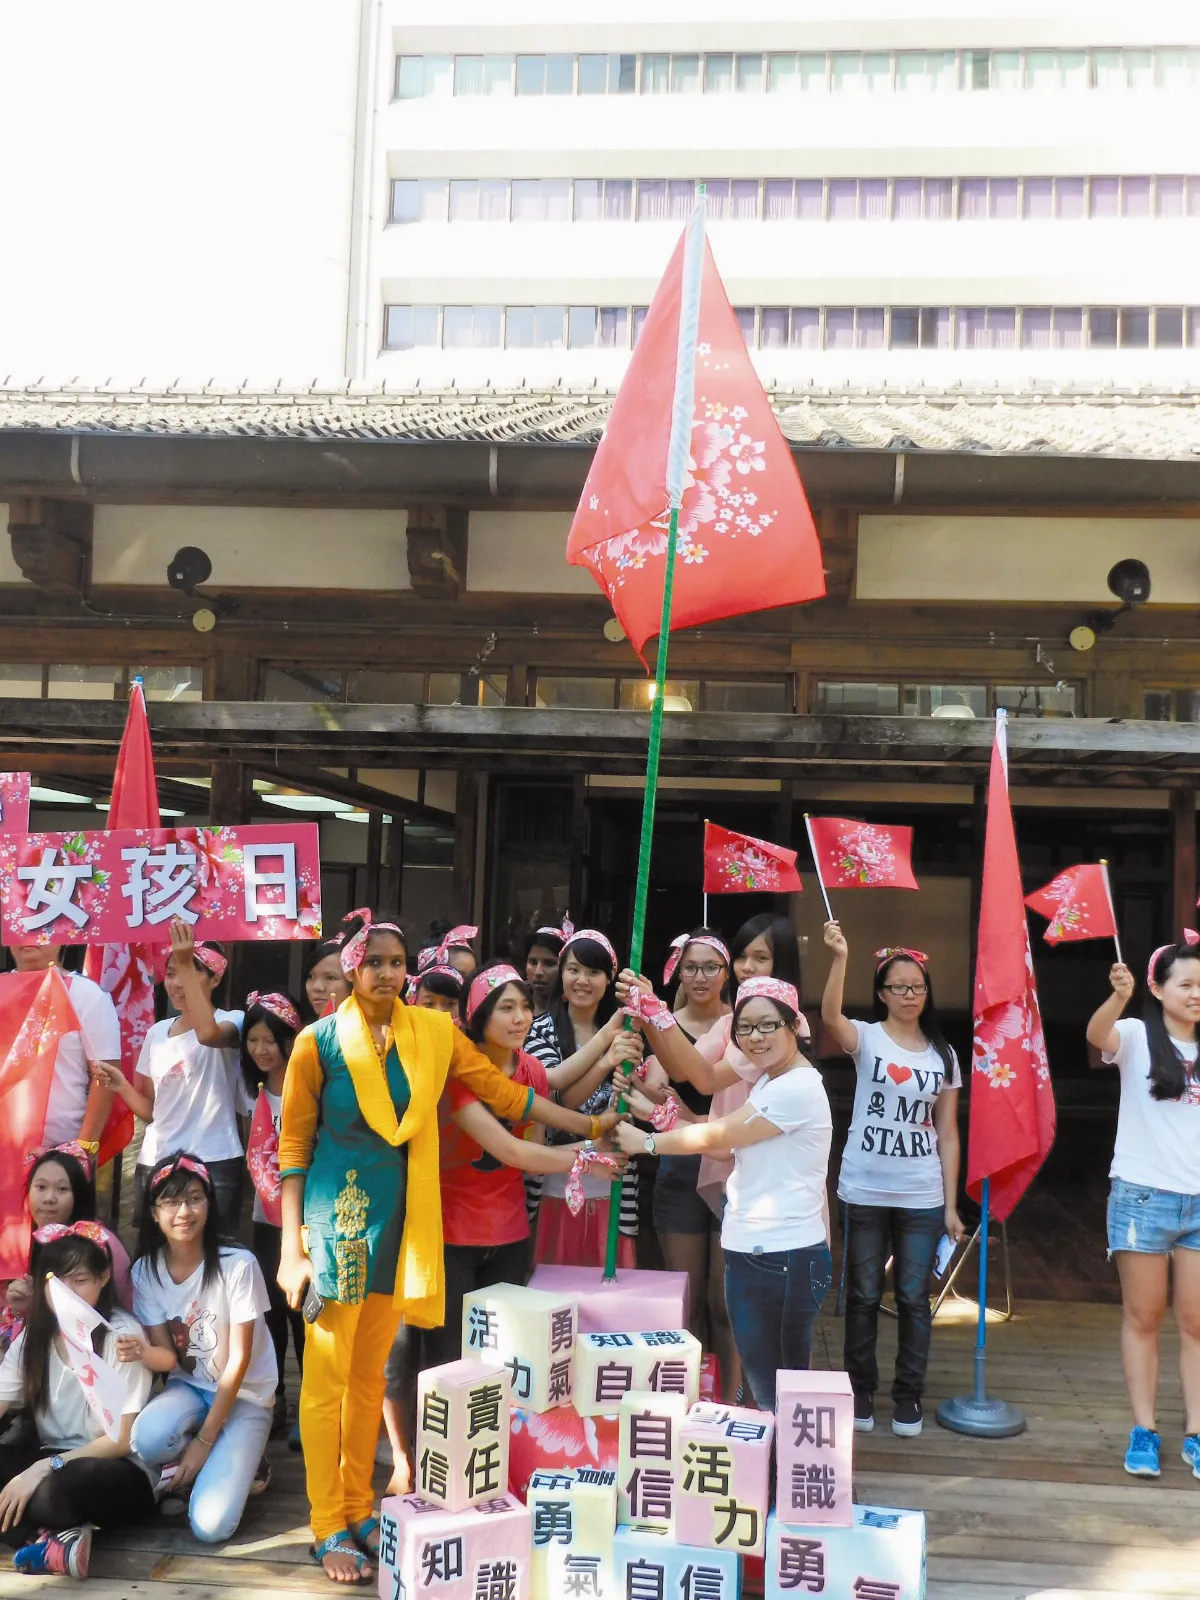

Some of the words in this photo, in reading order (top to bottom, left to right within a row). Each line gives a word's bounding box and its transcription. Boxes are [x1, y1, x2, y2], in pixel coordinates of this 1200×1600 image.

[18, 842, 298, 930] 女孩日
[861, 1125, 932, 1157] STAR!
[469, 1306, 531, 1398] 活力
[548, 1308, 573, 1402] 勇氣
[590, 1330, 685, 1347] 知識
[595, 1361, 687, 1402] 自信
[420, 1390, 449, 1499] 自信
[464, 1383, 503, 1499] 責任
[625, 1410, 674, 1519] 自信
[791, 1403, 836, 1509] 知識
[682, 1442, 758, 1547] 活力
[421, 1536, 518, 1600] 知識
[533, 1500, 604, 1598] 勇氣
